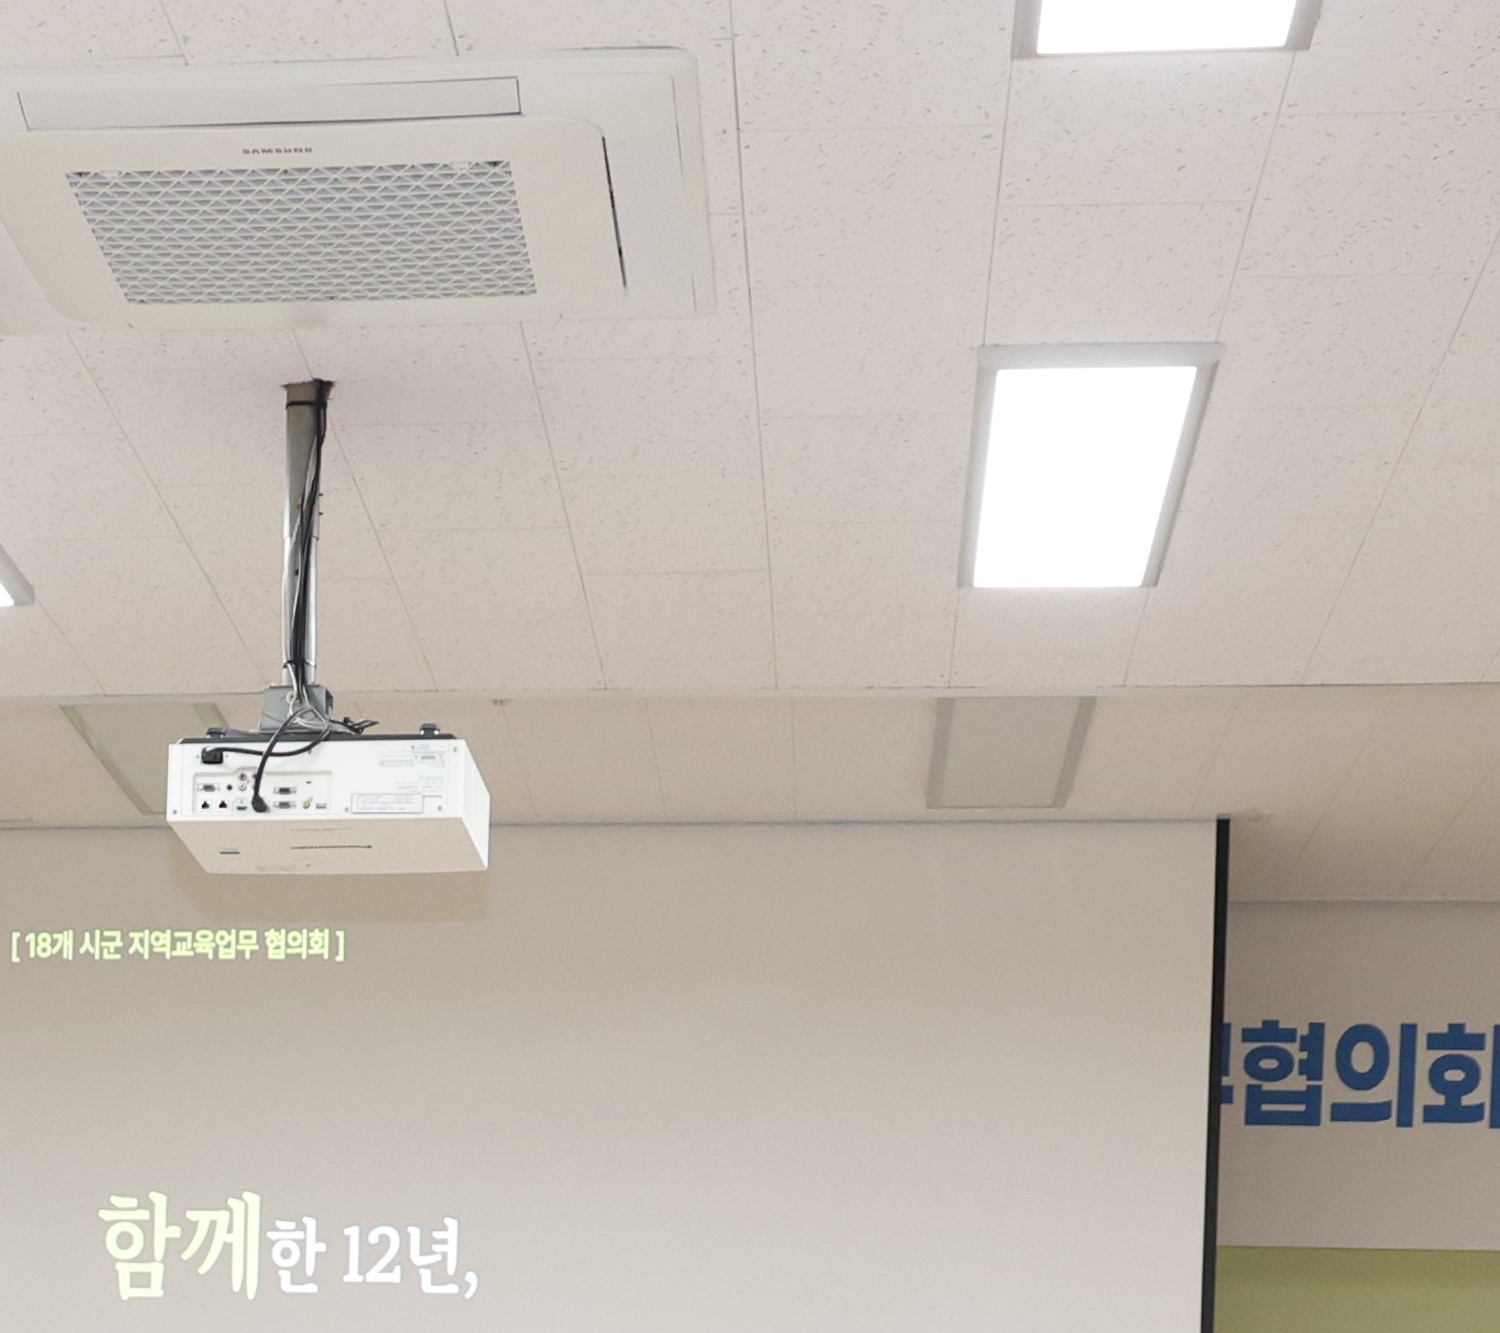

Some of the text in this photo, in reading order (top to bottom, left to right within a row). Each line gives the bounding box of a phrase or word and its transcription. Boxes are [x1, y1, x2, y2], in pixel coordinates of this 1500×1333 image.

[79, 930, 123, 960] 시군
[128, 929, 259, 960] 지역교육업무
[265, 929, 329, 960] 협의회
[97, 1190, 479, 1301] 함께한 12년,
